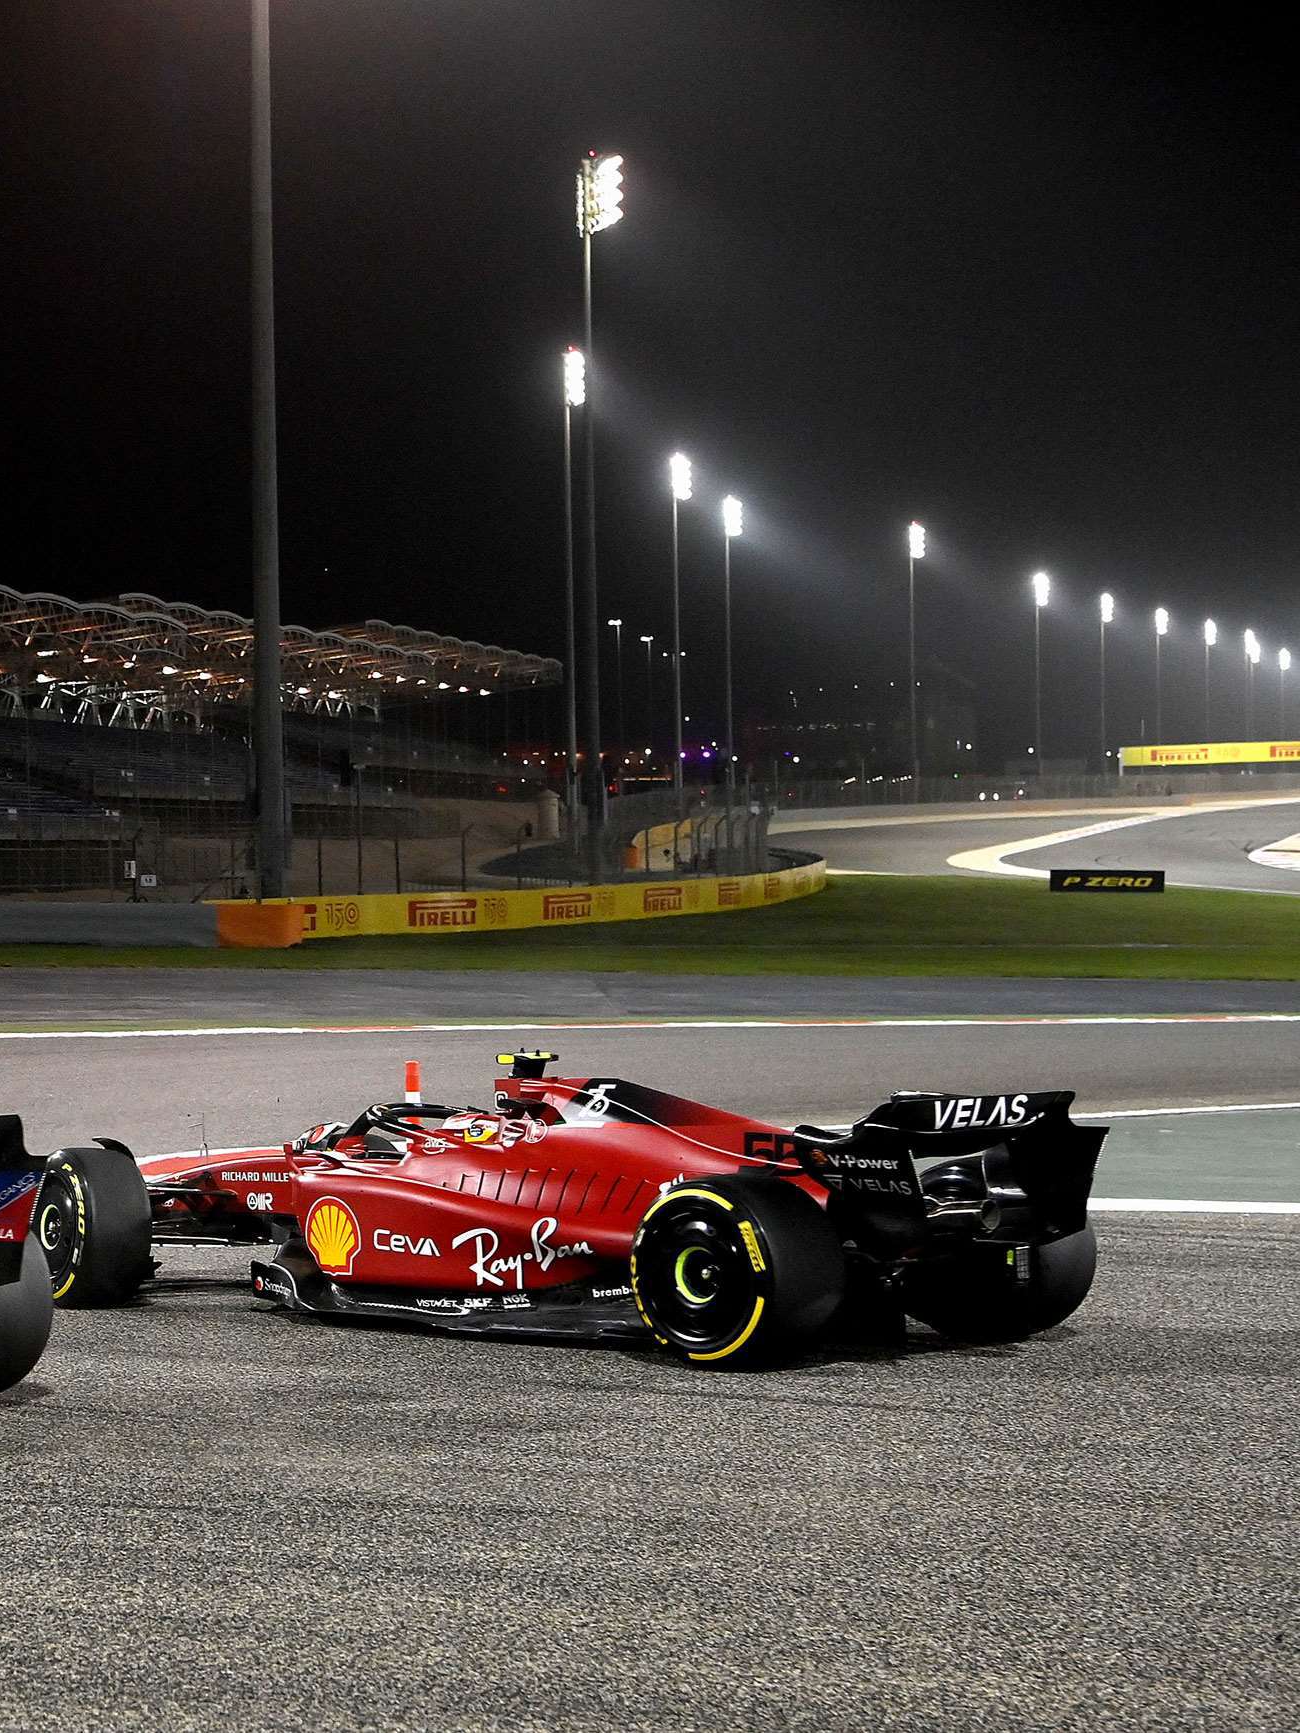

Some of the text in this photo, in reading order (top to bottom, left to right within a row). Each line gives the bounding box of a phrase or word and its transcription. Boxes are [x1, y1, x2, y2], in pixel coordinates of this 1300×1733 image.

[1063, 876, 1153, 887] P ZERO
[408, 900, 477, 927] PIRELLI
[543, 893, 592, 920] PIRELLI
[934, 1094, 1028, 1130] VELAS
[828, 1153, 899, 1170] V-Power
[221, 1171, 289, 1182] RICHARD MILLE
[849, 1177, 912, 1195] VELAS
[592, 1285, 634, 1298] bremb
